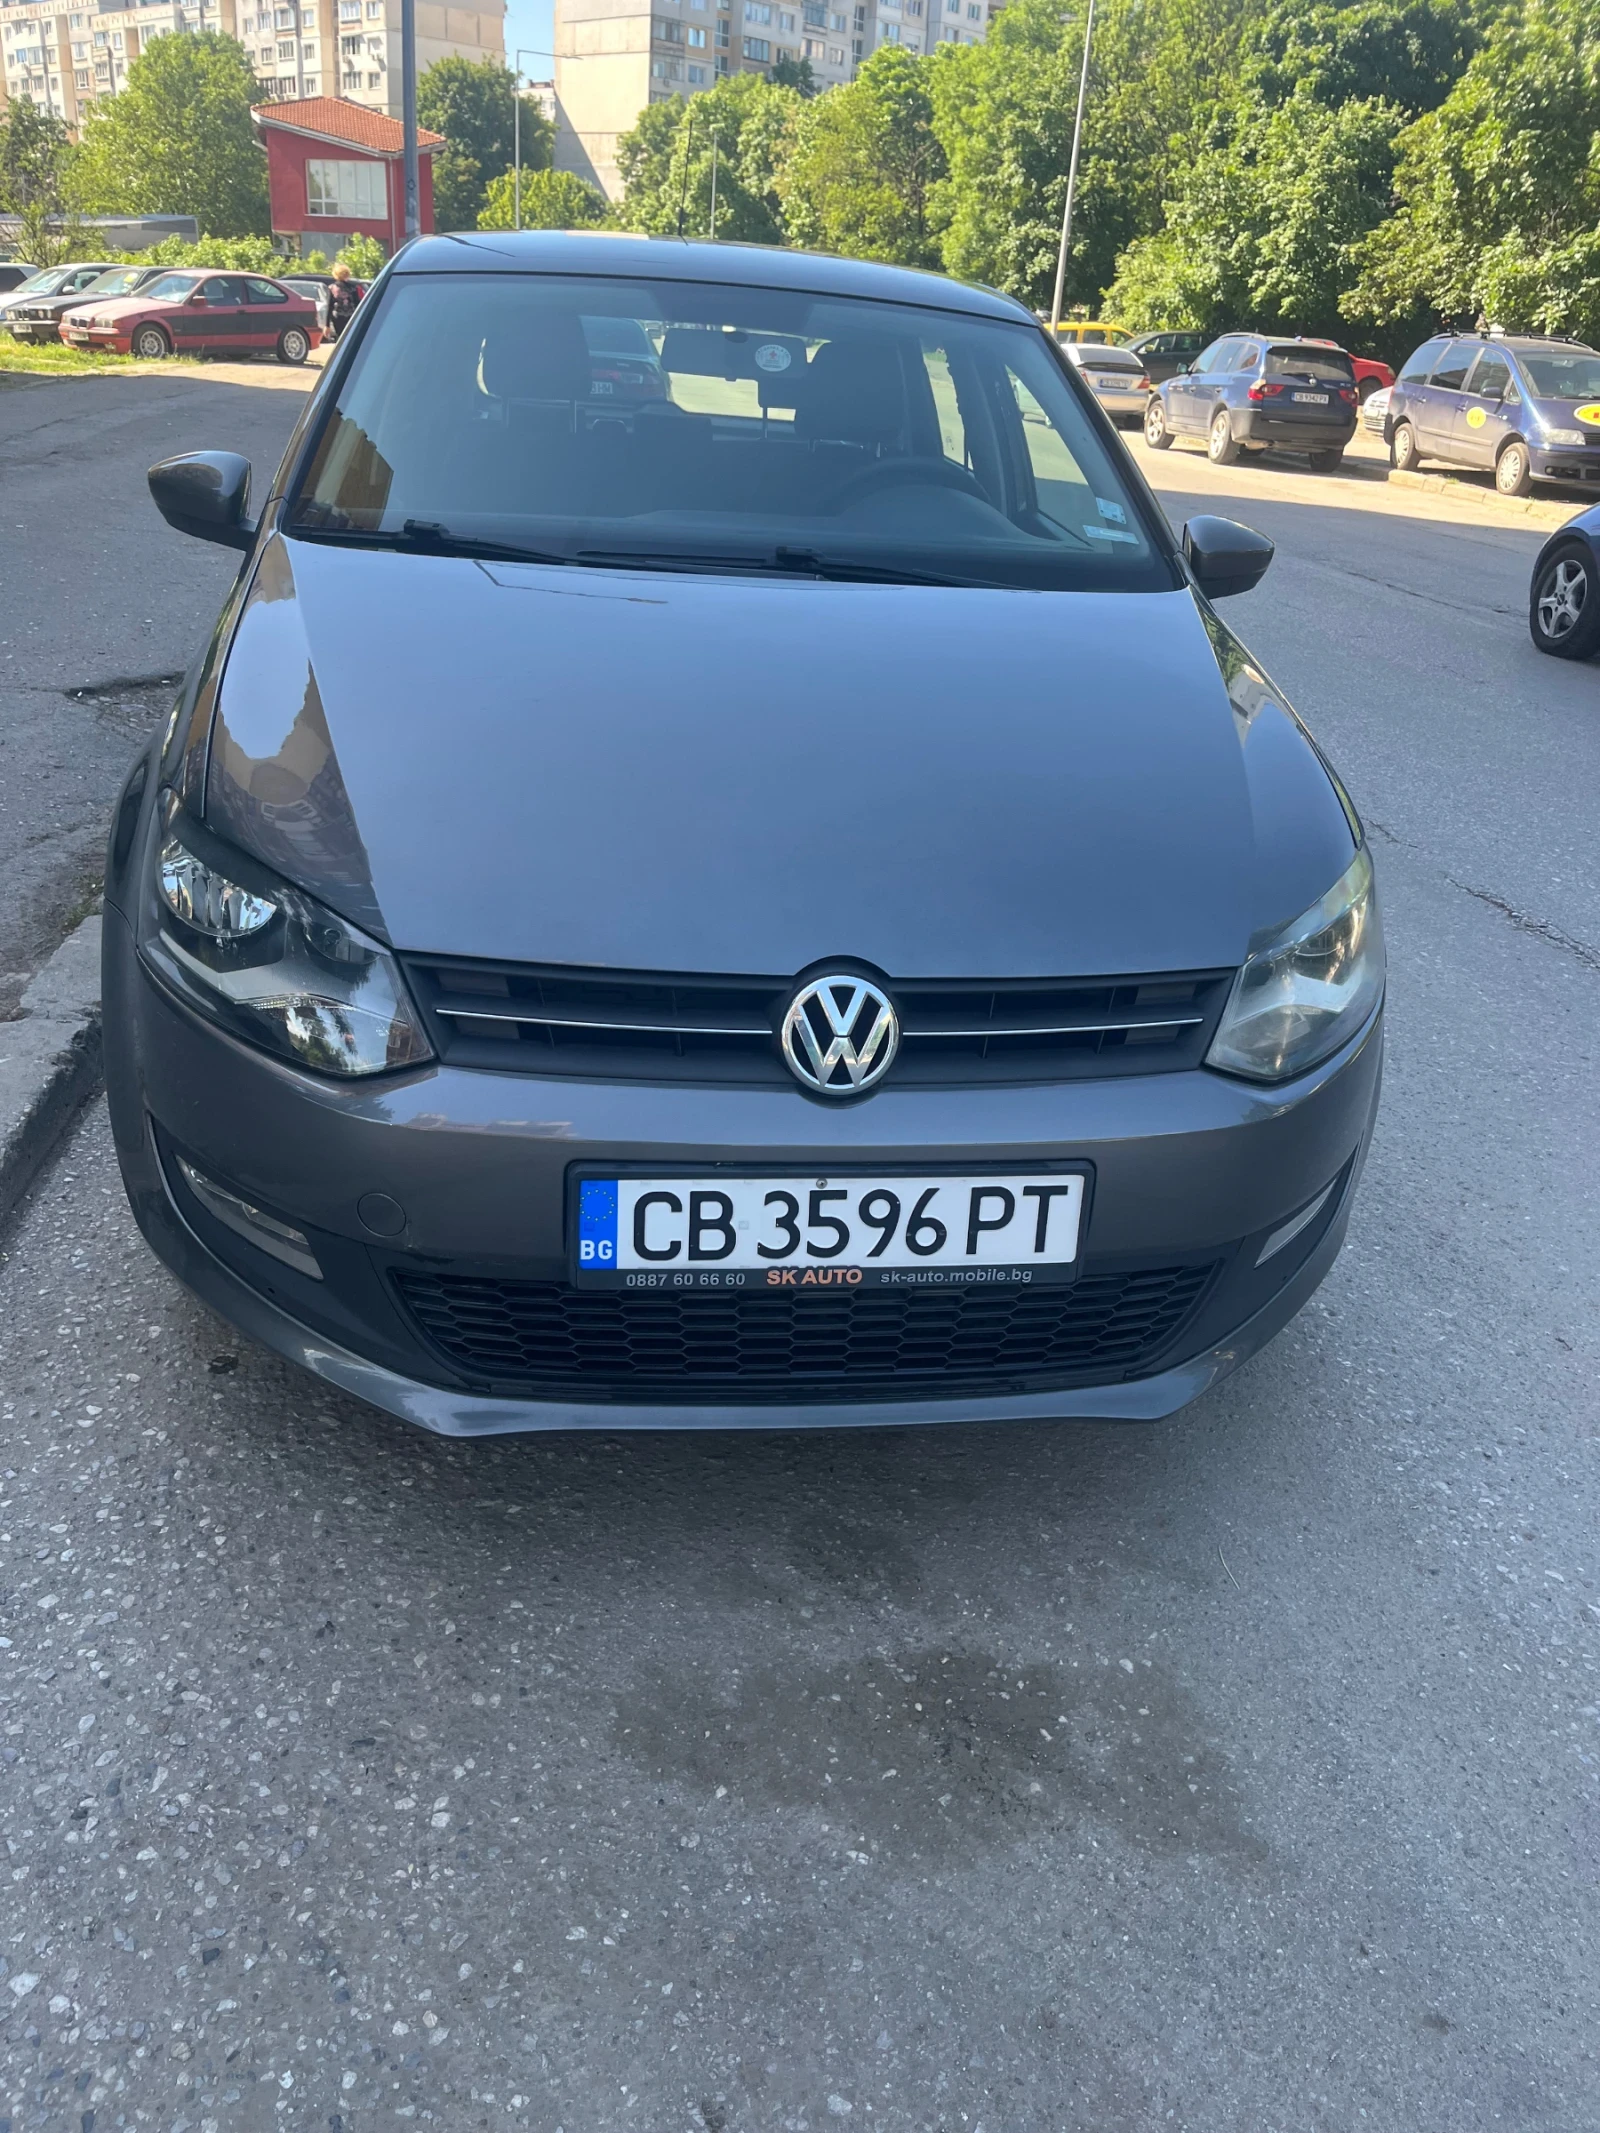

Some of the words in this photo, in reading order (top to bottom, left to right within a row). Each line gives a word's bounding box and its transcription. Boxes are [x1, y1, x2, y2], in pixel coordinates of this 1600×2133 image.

[633, 1190, 736, 1261] CB
[757, 1187, 947, 1260] 3596
[966, 1185, 1068, 1255] PT
[580, 1239, 613, 1260] BG
[626, 1273, 668, 1287] 0887
[673, 1273, 694, 1286] 60
[699, 1272, 720, 1285] 66
[725, 1272, 746, 1285] 60
[766, 1269, 797, 1285] SK
[801, 1268, 863, 1285] AUTO
[880, 1267, 1033, 1284] sk-auto.mobile.bg
